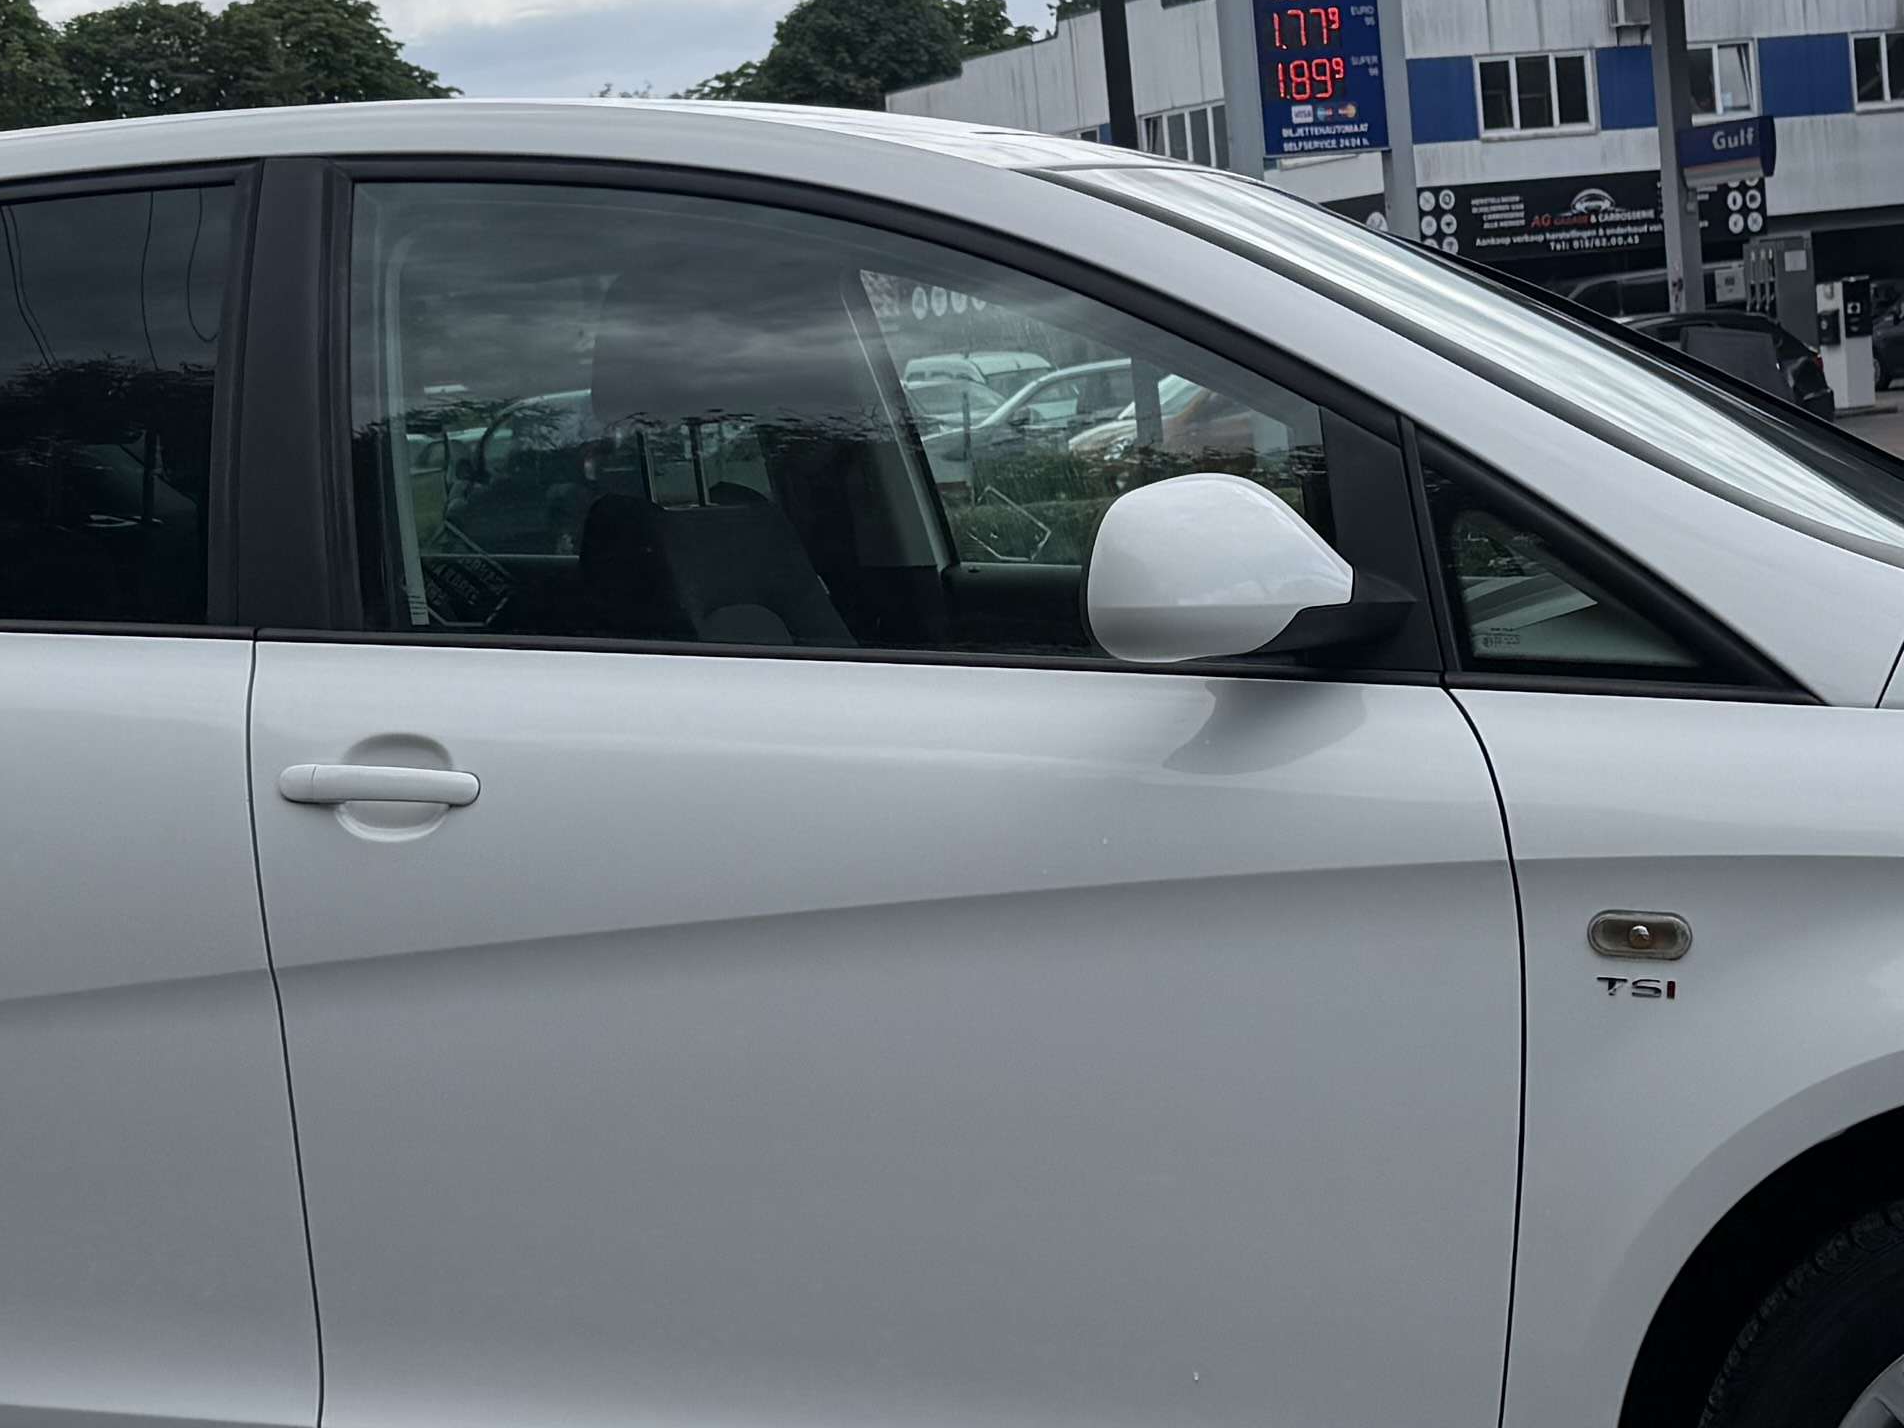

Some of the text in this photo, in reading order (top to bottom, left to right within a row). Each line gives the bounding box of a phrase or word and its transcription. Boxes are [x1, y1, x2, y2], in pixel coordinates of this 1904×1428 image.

[1712, 127, 1754, 150] Gulf
[1531, 214, 1552, 228] AG
[1597, 976, 1676, 999] TSI
